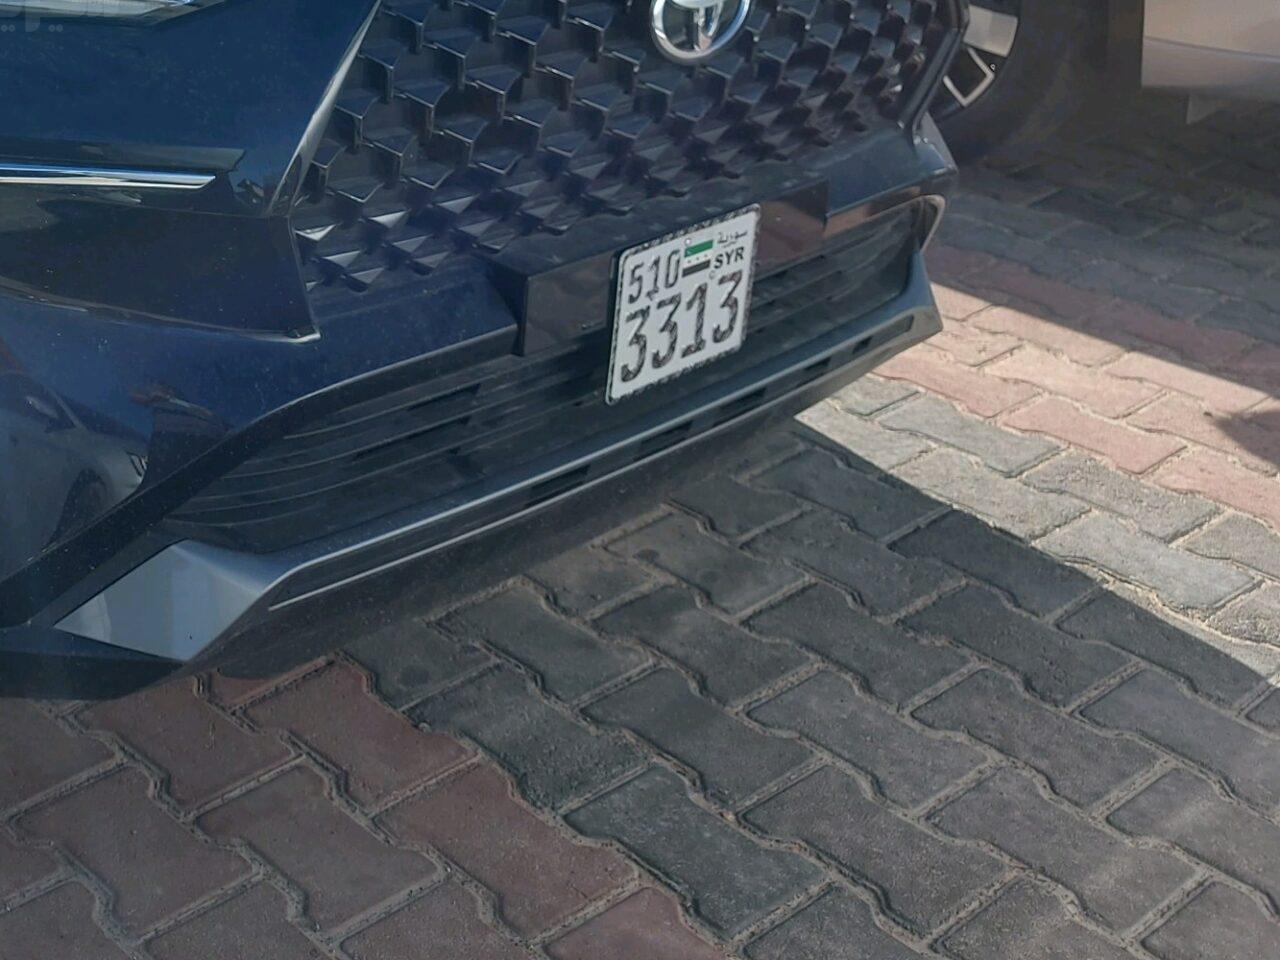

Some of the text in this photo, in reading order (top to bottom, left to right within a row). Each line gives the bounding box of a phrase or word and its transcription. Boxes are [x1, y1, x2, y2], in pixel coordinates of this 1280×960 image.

[628, 249, 681, 305] 510
[713, 246, 745, 270] SYR
[620, 269, 743, 383] 3313
